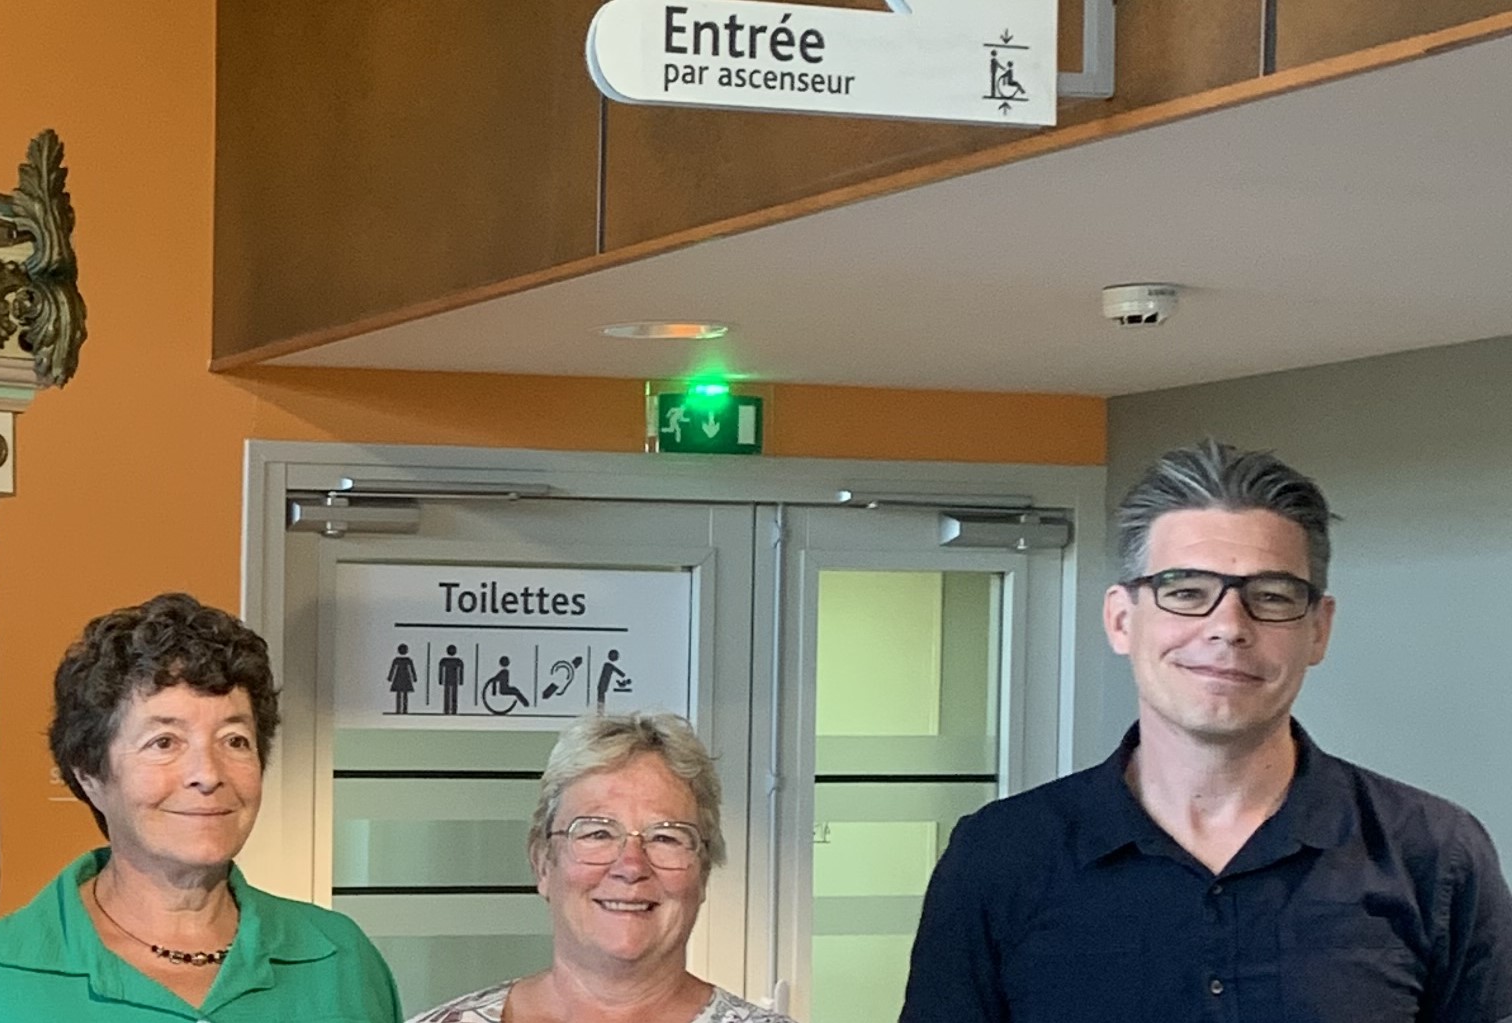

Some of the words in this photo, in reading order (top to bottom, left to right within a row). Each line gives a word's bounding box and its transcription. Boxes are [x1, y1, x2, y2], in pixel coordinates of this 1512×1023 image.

[664, 5, 825, 64] Entrée
[664, 63, 709, 92] par
[718, 66, 855, 95] ascenseur
[438, 581, 586, 616] Toilettes
